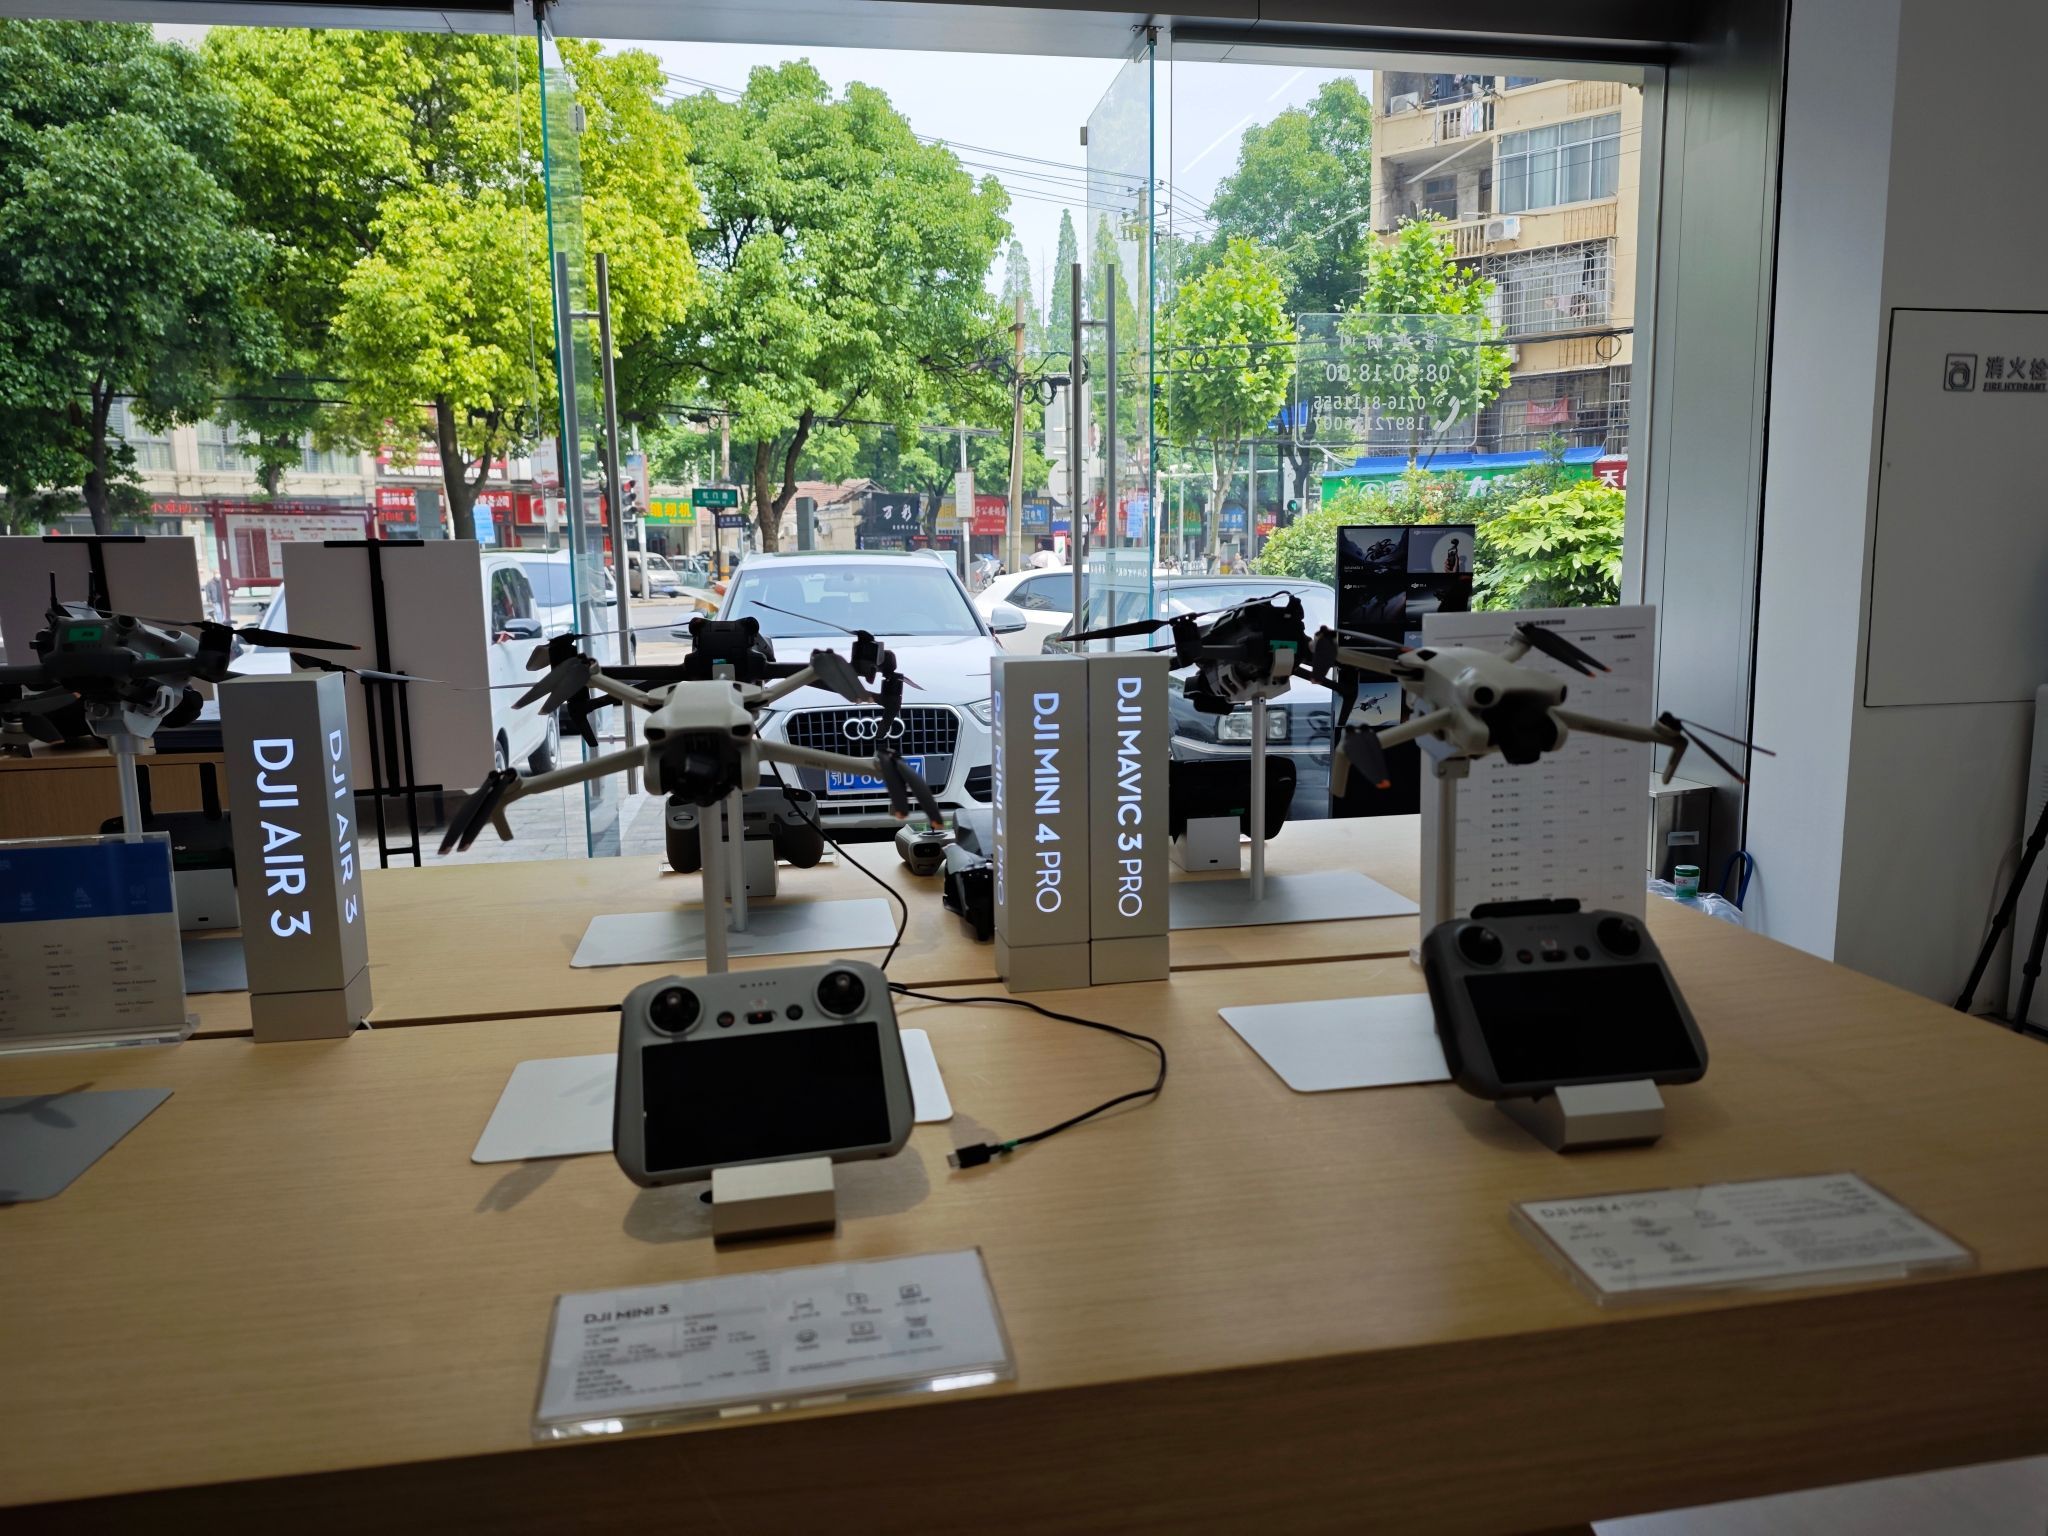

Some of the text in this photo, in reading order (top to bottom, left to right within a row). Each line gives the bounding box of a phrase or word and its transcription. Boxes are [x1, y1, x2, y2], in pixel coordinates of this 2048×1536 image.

[1985, 355, 2048, 381] 消火栓
[1600, 469, 1628, 487] 天
[253, 738, 312, 938] DJI AIR 3
[329, 729, 358, 924] DJI AIR 3
[1033, 692, 1062, 913] DJI MINI 4 PRO
[1117, 677, 1142, 917] DJI MAVIC 3 PRO
[583, 1312, 613, 1324] DJI
[616, 1306, 655, 1320] MINI
